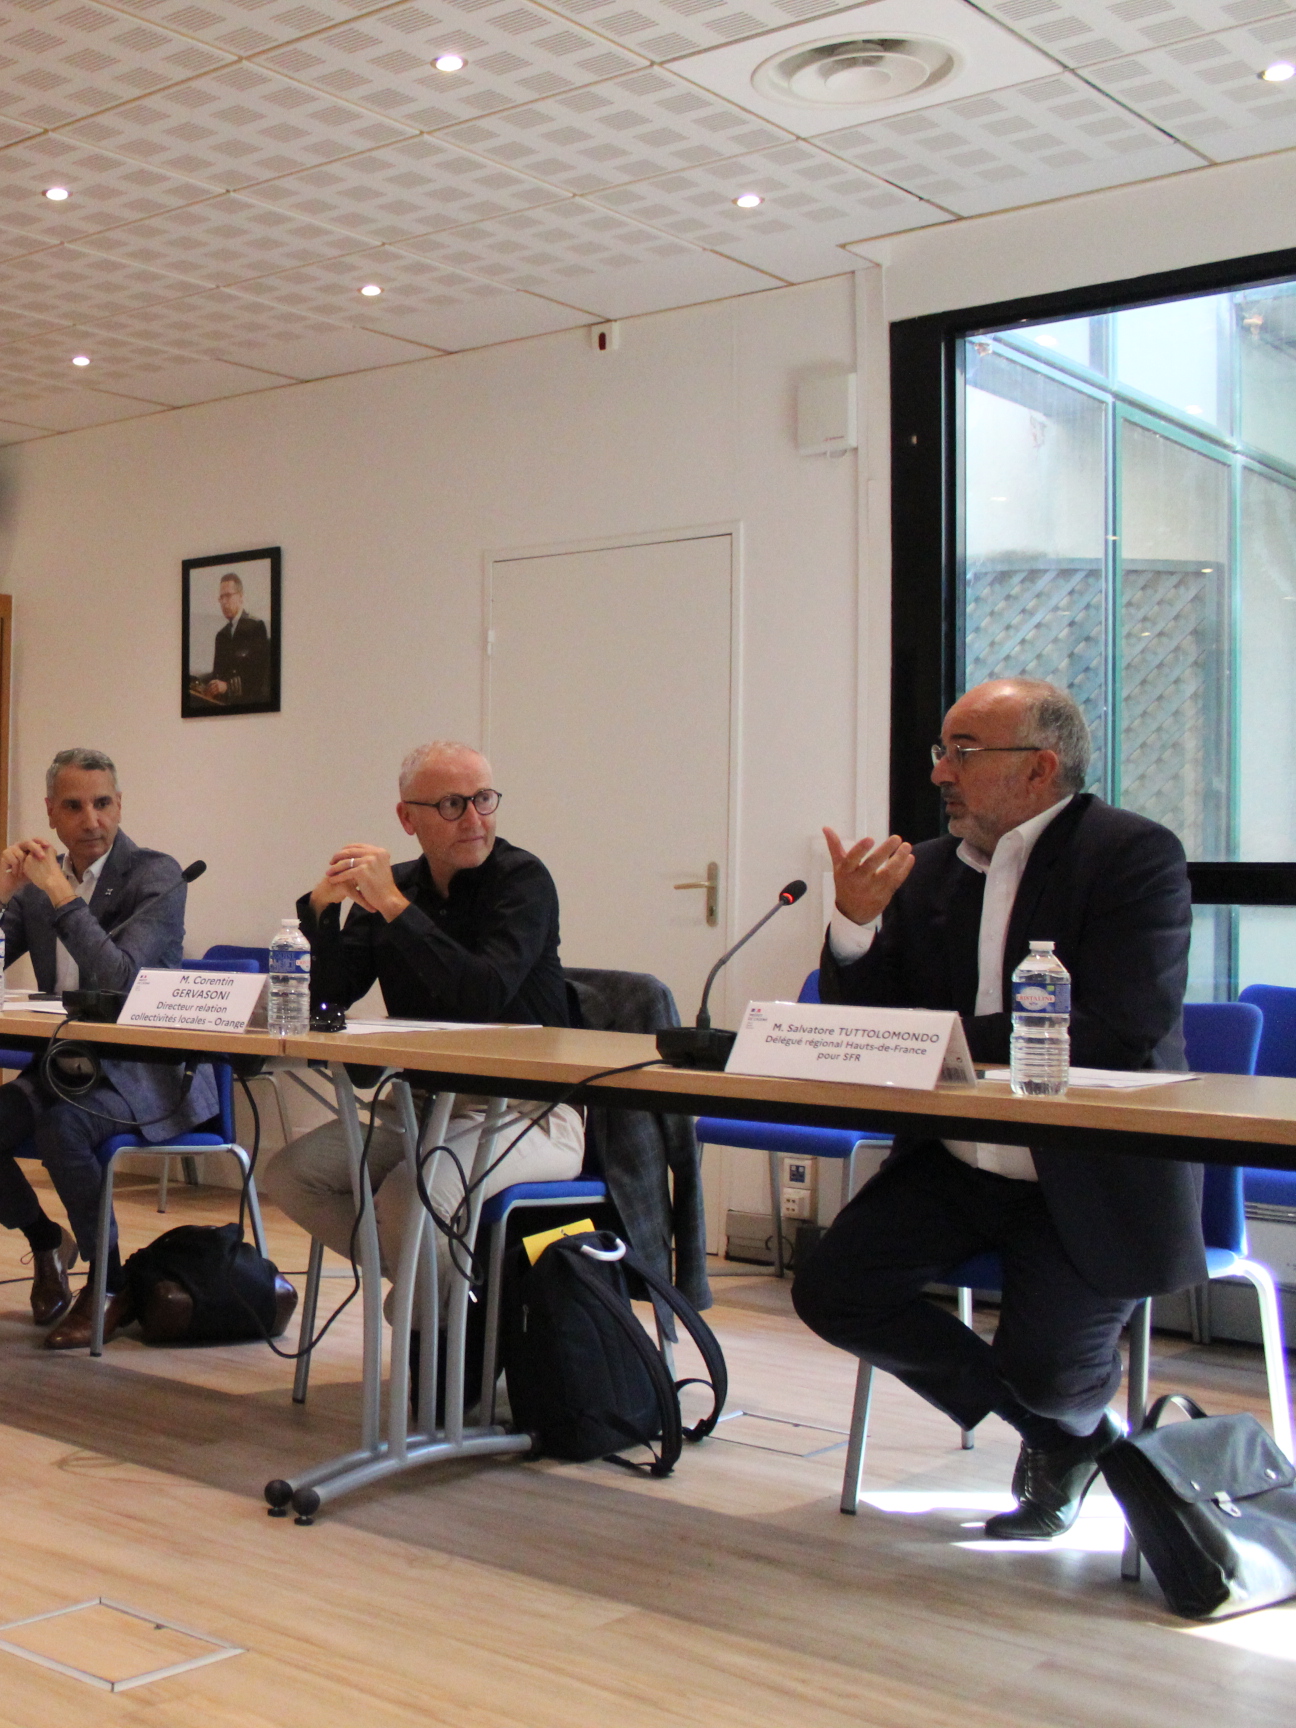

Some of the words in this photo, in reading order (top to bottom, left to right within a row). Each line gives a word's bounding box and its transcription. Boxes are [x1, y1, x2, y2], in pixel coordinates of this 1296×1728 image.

[179, 975, 190, 984] M.
[193, 975, 235, 987] Corentin
[172, 988, 231, 1000] GERVASONI
[156, 1001, 194, 1011] Directeur
[195, 1003, 228, 1013] relation
[130, 1012, 177, 1024] collectivités
[178, 1014, 207, 1026] locales
[214, 1017, 245, 1029] Orange
[772, 1023, 784, 1032] M.
[786, 1023, 836, 1036] Salvatore
[838, 1027, 940, 1043] TUTTOLOMONDO
[765, 1034, 803, 1046] Délégué
[804, 1037, 844, 1050] régional
[845, 1041, 927, 1056] Hauts-de-France
[816, 1053, 841, 1061] pour
[842, 1052, 861, 1062] SFR
